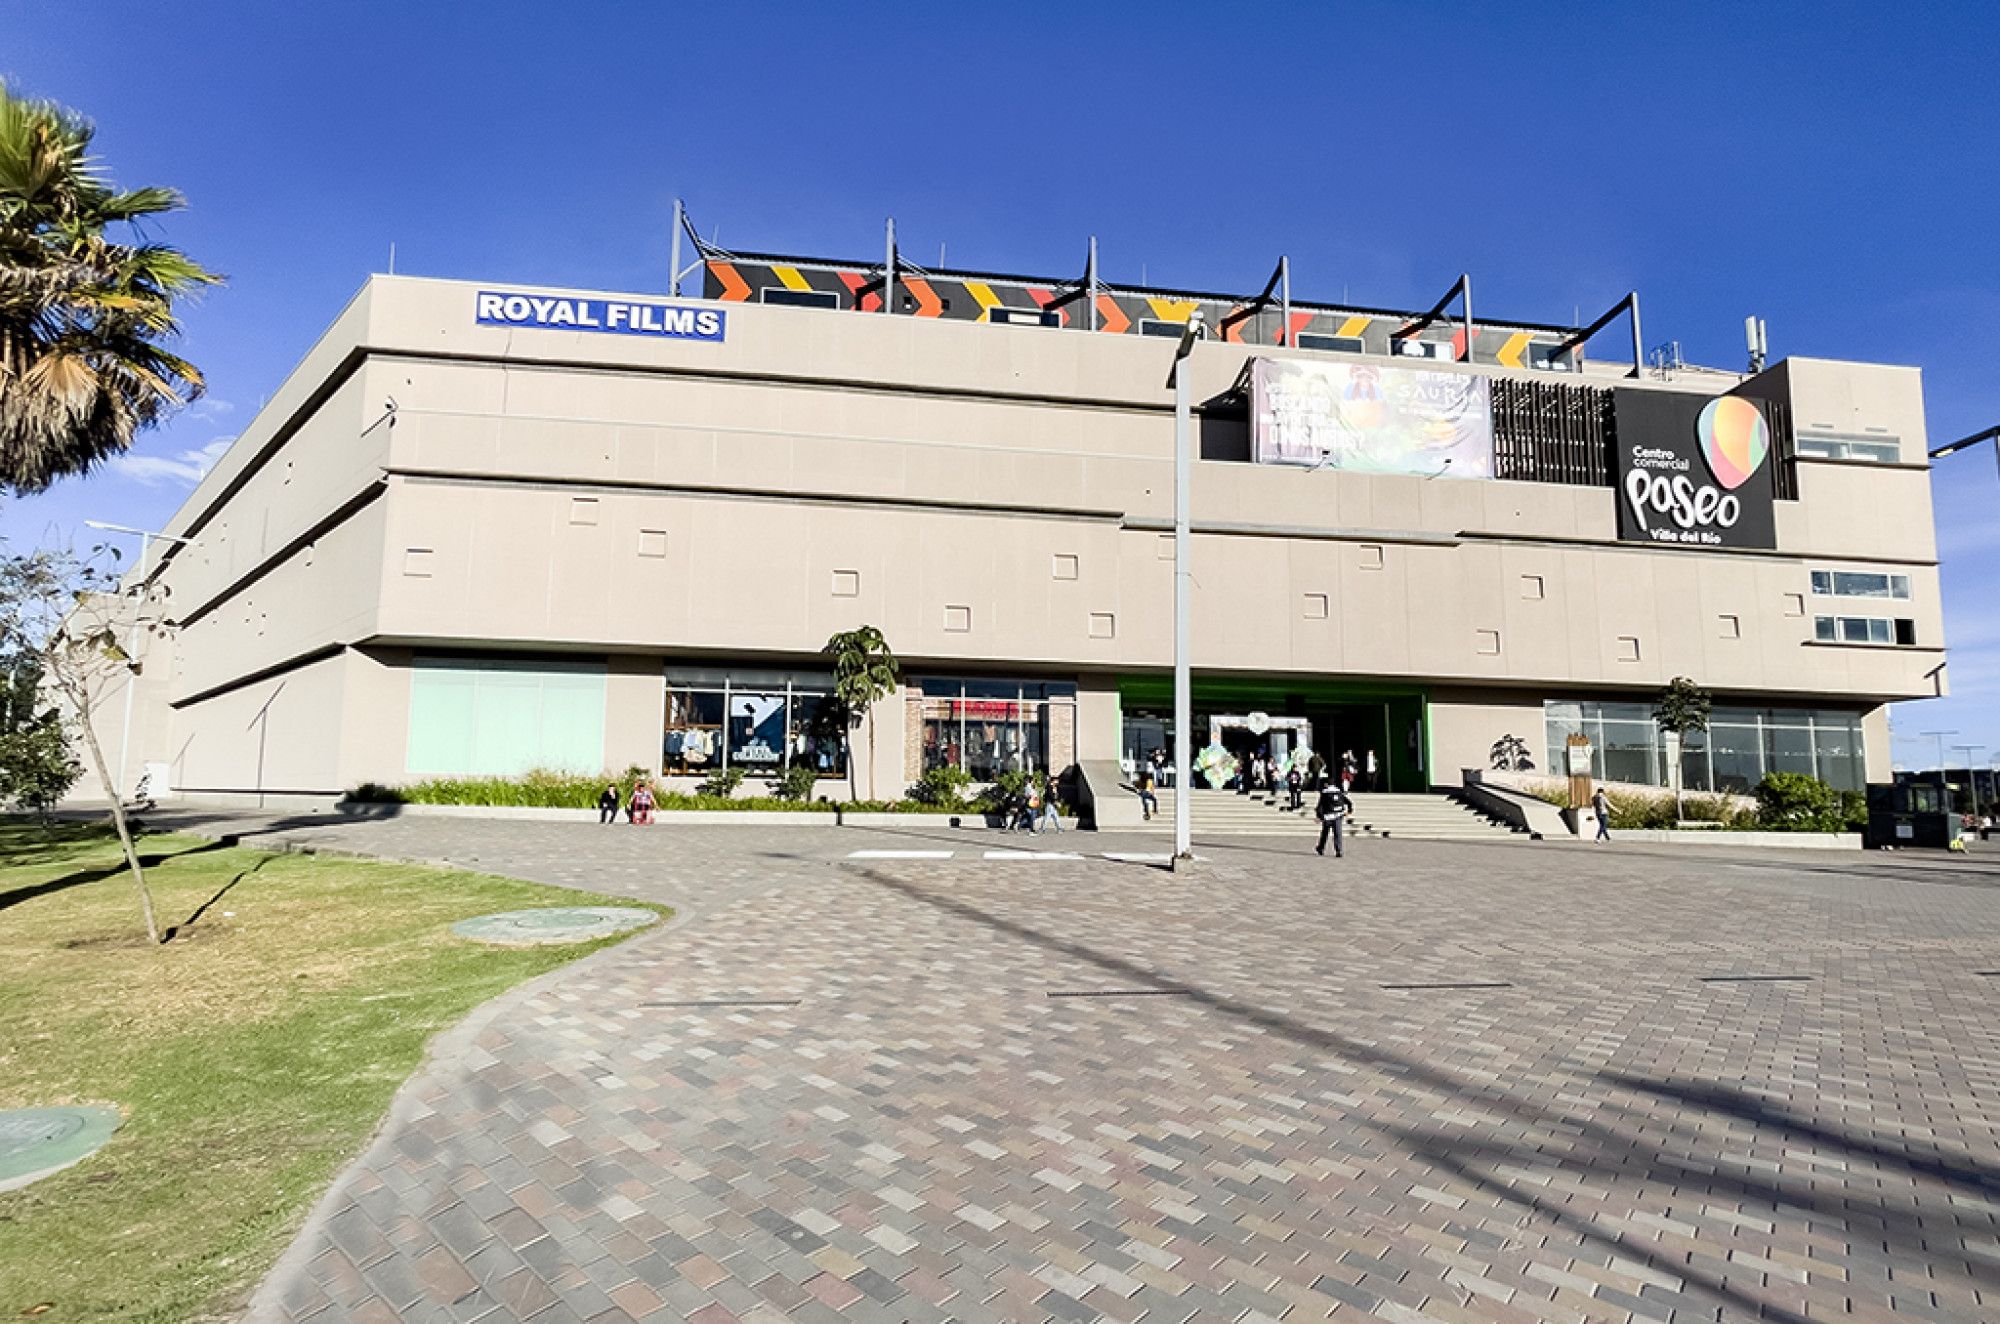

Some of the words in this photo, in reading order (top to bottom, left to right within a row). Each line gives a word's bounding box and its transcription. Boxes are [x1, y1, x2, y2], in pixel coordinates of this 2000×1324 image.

[479, 294, 599, 327] ROYAL
[606, 304, 720, 335] FILMS
[1632, 445, 1675, 459] Centro
[1680, 531, 1699, 542] del
